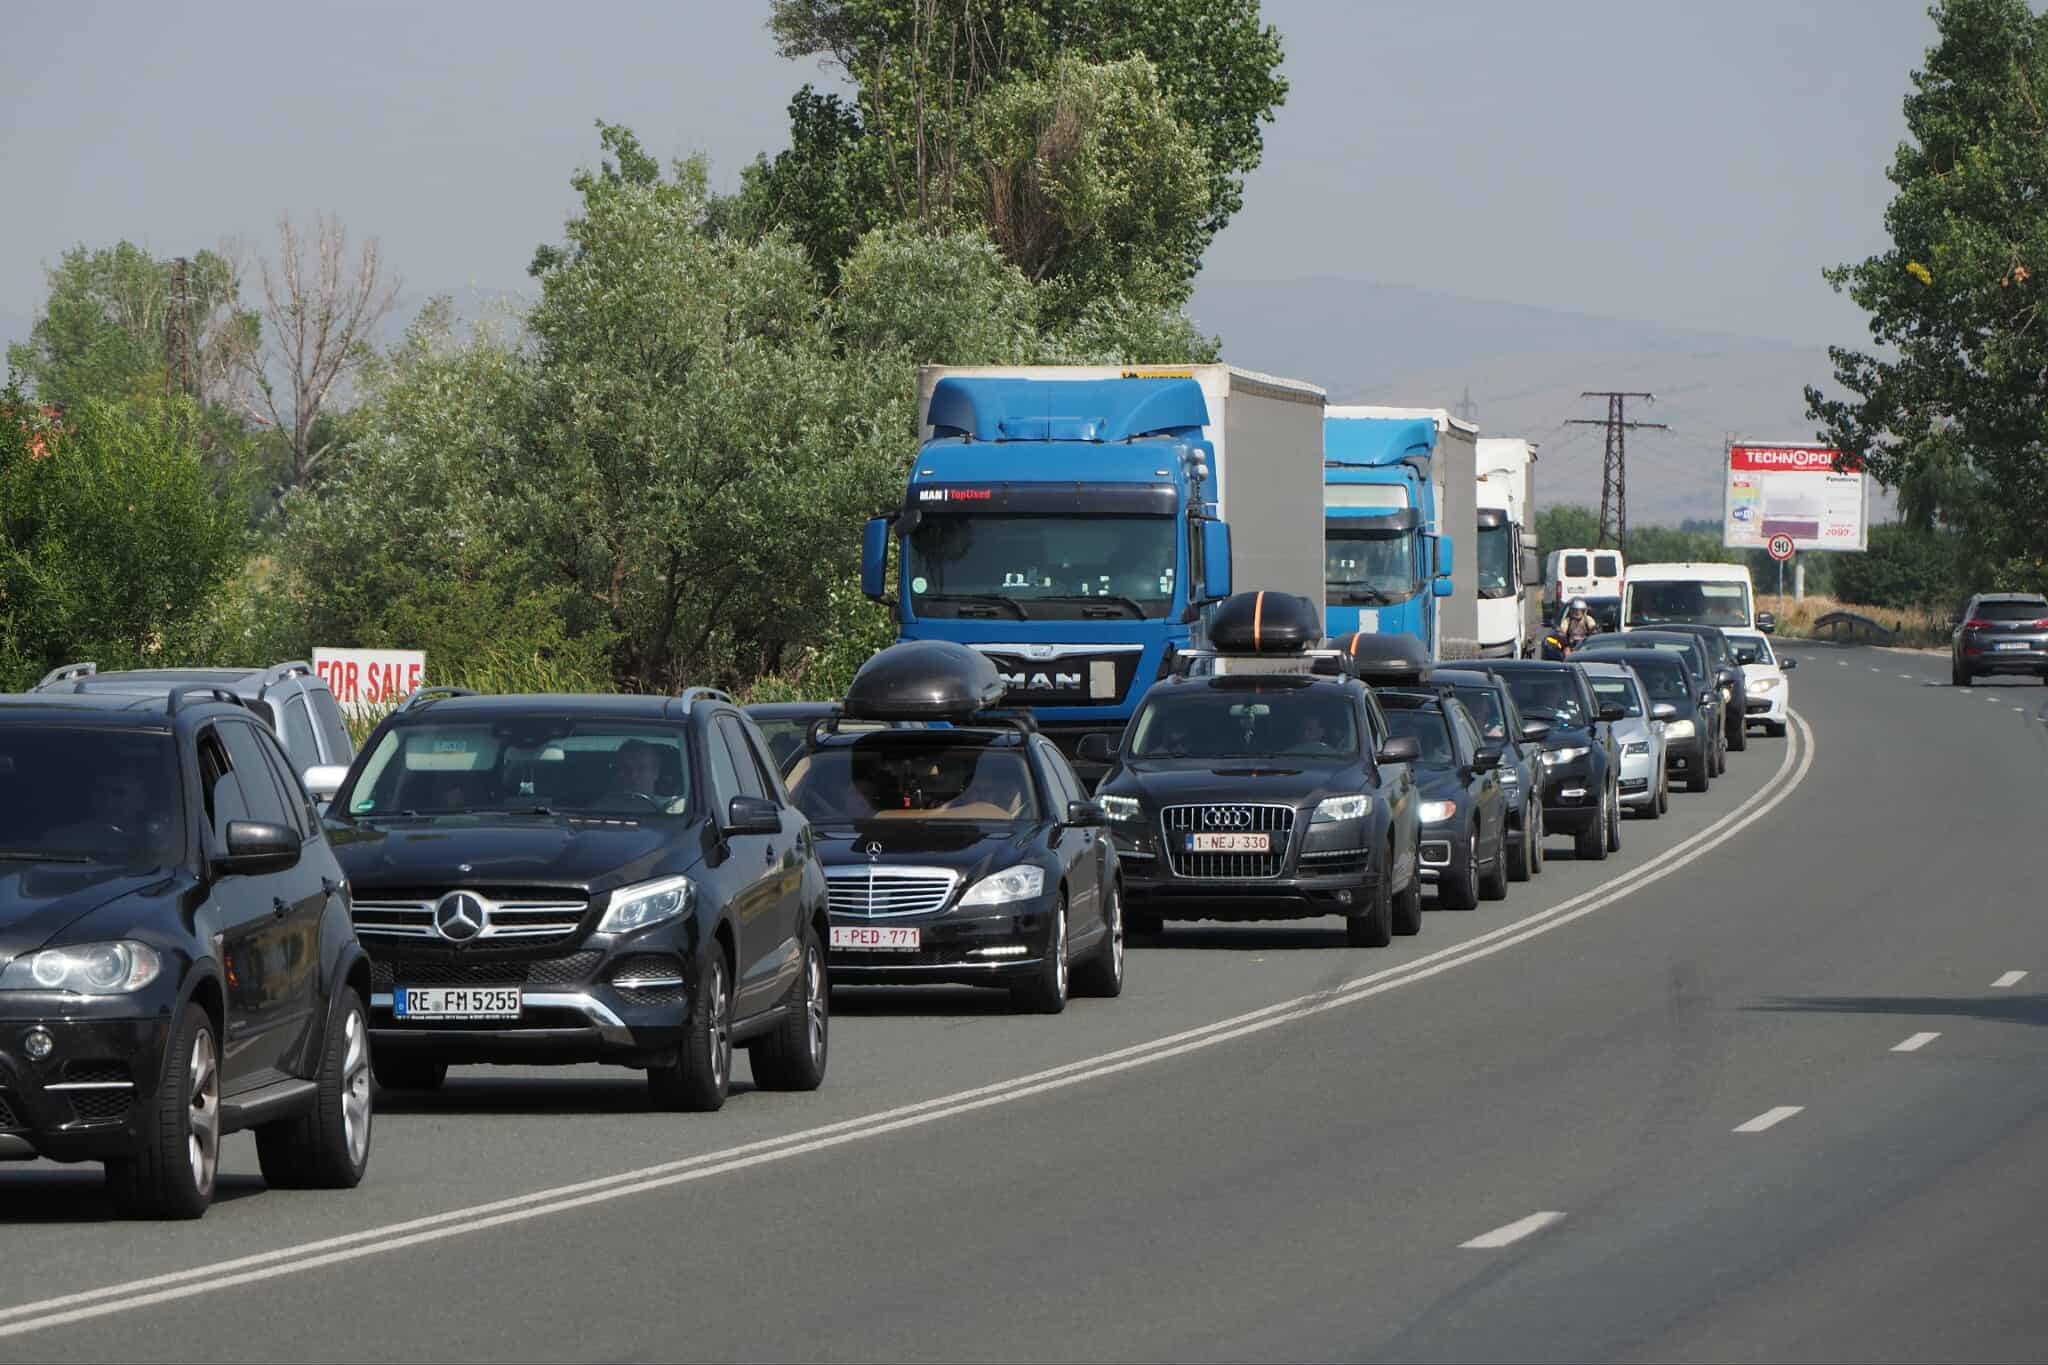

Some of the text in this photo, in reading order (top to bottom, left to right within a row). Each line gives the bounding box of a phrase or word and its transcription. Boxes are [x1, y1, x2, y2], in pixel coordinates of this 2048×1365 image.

[1744, 451, 1845, 466] TECHNOPOL
[919, 490, 943, 500] MAN
[1773, 540, 1789, 553] 90
[317, 661, 421, 704] FOR SALE
[998, 672, 1081, 690] MAN
[833, 928, 918, 945] 1-PED-771
[407, 991, 430, 1011] RE
